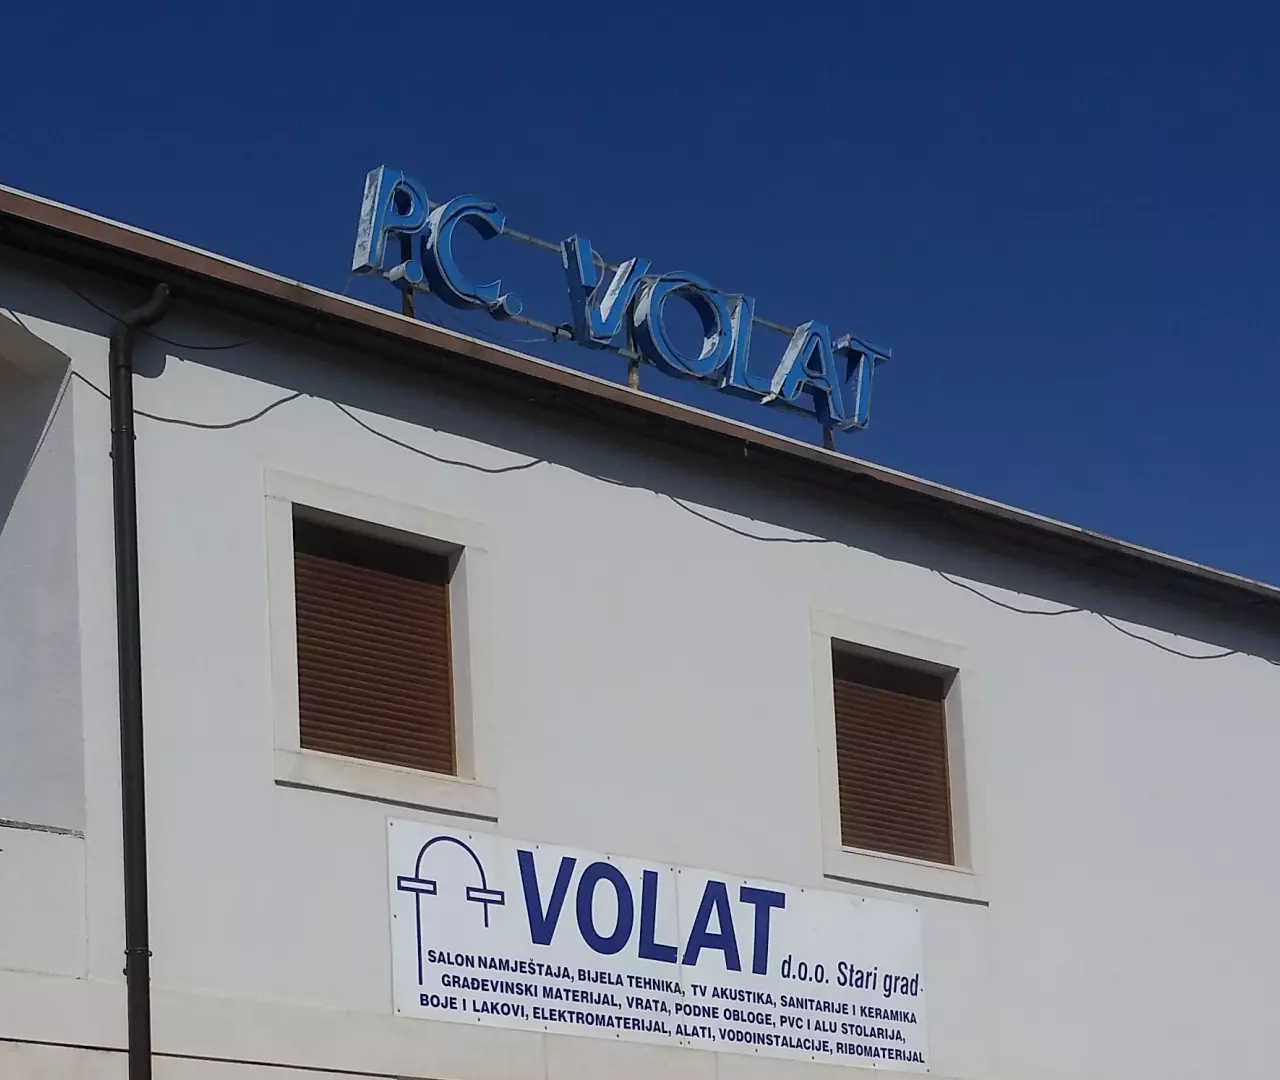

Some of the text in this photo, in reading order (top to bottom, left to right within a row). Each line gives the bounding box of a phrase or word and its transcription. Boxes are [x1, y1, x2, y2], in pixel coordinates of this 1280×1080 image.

[352, 164, 892, 433] P.C. VOLAT
[516, 849, 920, 998] VOLAT d.o.o. Stari grad
[428, 949, 917, 1025] SALON NAMJEŠTAJA, BIJELA TEHNIKA, TV AKUSTIKA, SANITARIJE I KERAMIKA
[441, 973, 906, 1044] GRAĐEVINSKI MATERIJAL, VRATA, PODNE OBLOGE, PVC I ALU STOLARIJA,
[419, 993, 926, 1064] BOJE I LAKOVI, ELEKTROMATERIJAL, ALATI, VODOINSTALACIJE, RIBOMATERIJAL
